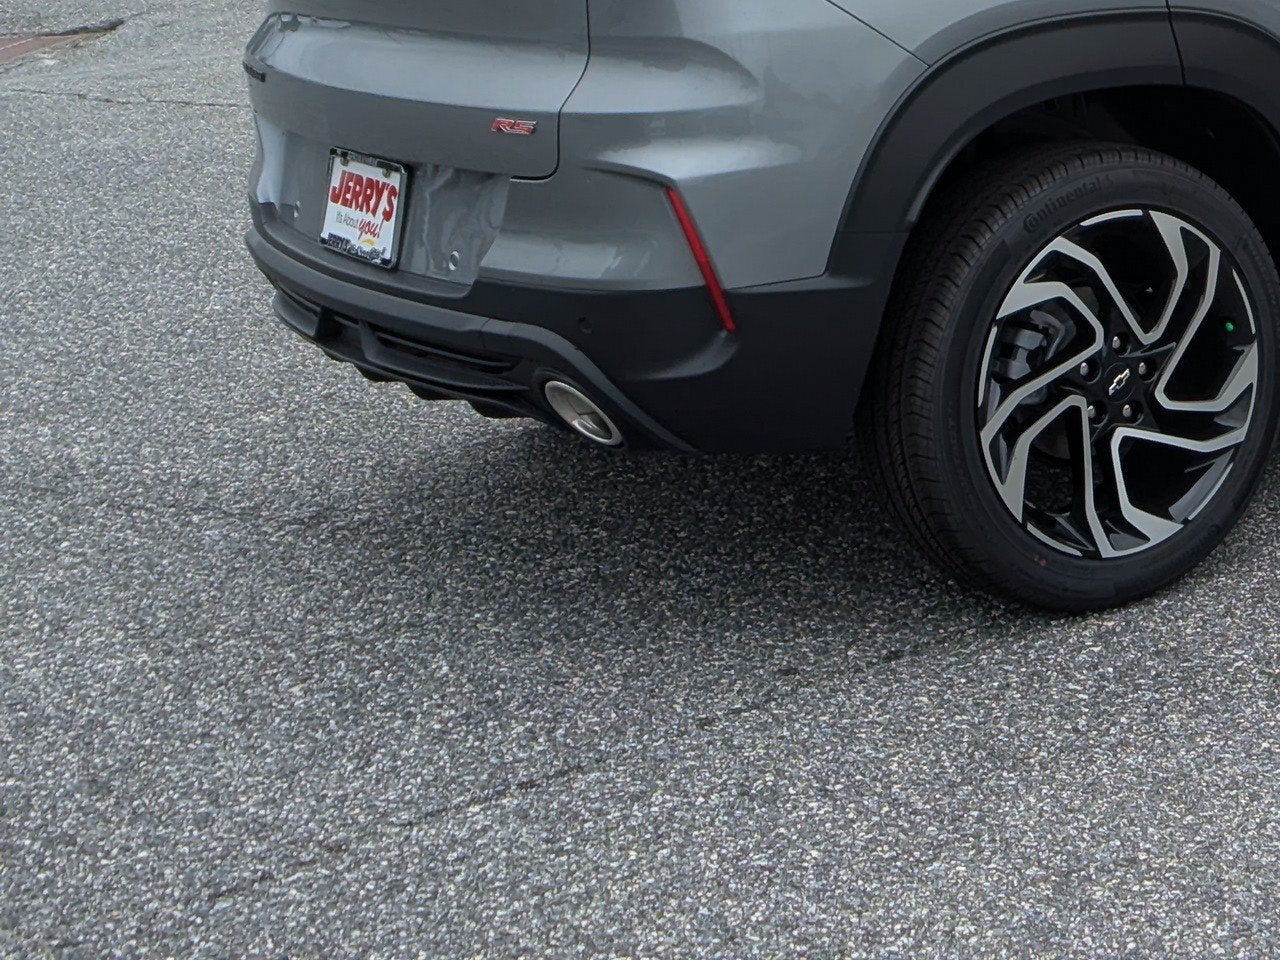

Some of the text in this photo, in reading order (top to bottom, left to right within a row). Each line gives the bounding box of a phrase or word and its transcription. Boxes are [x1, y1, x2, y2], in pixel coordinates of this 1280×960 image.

[491, 118, 538, 135] RS
[330, 170, 398, 222] JERRY'S
[1023, 176, 1103, 233] Continental
